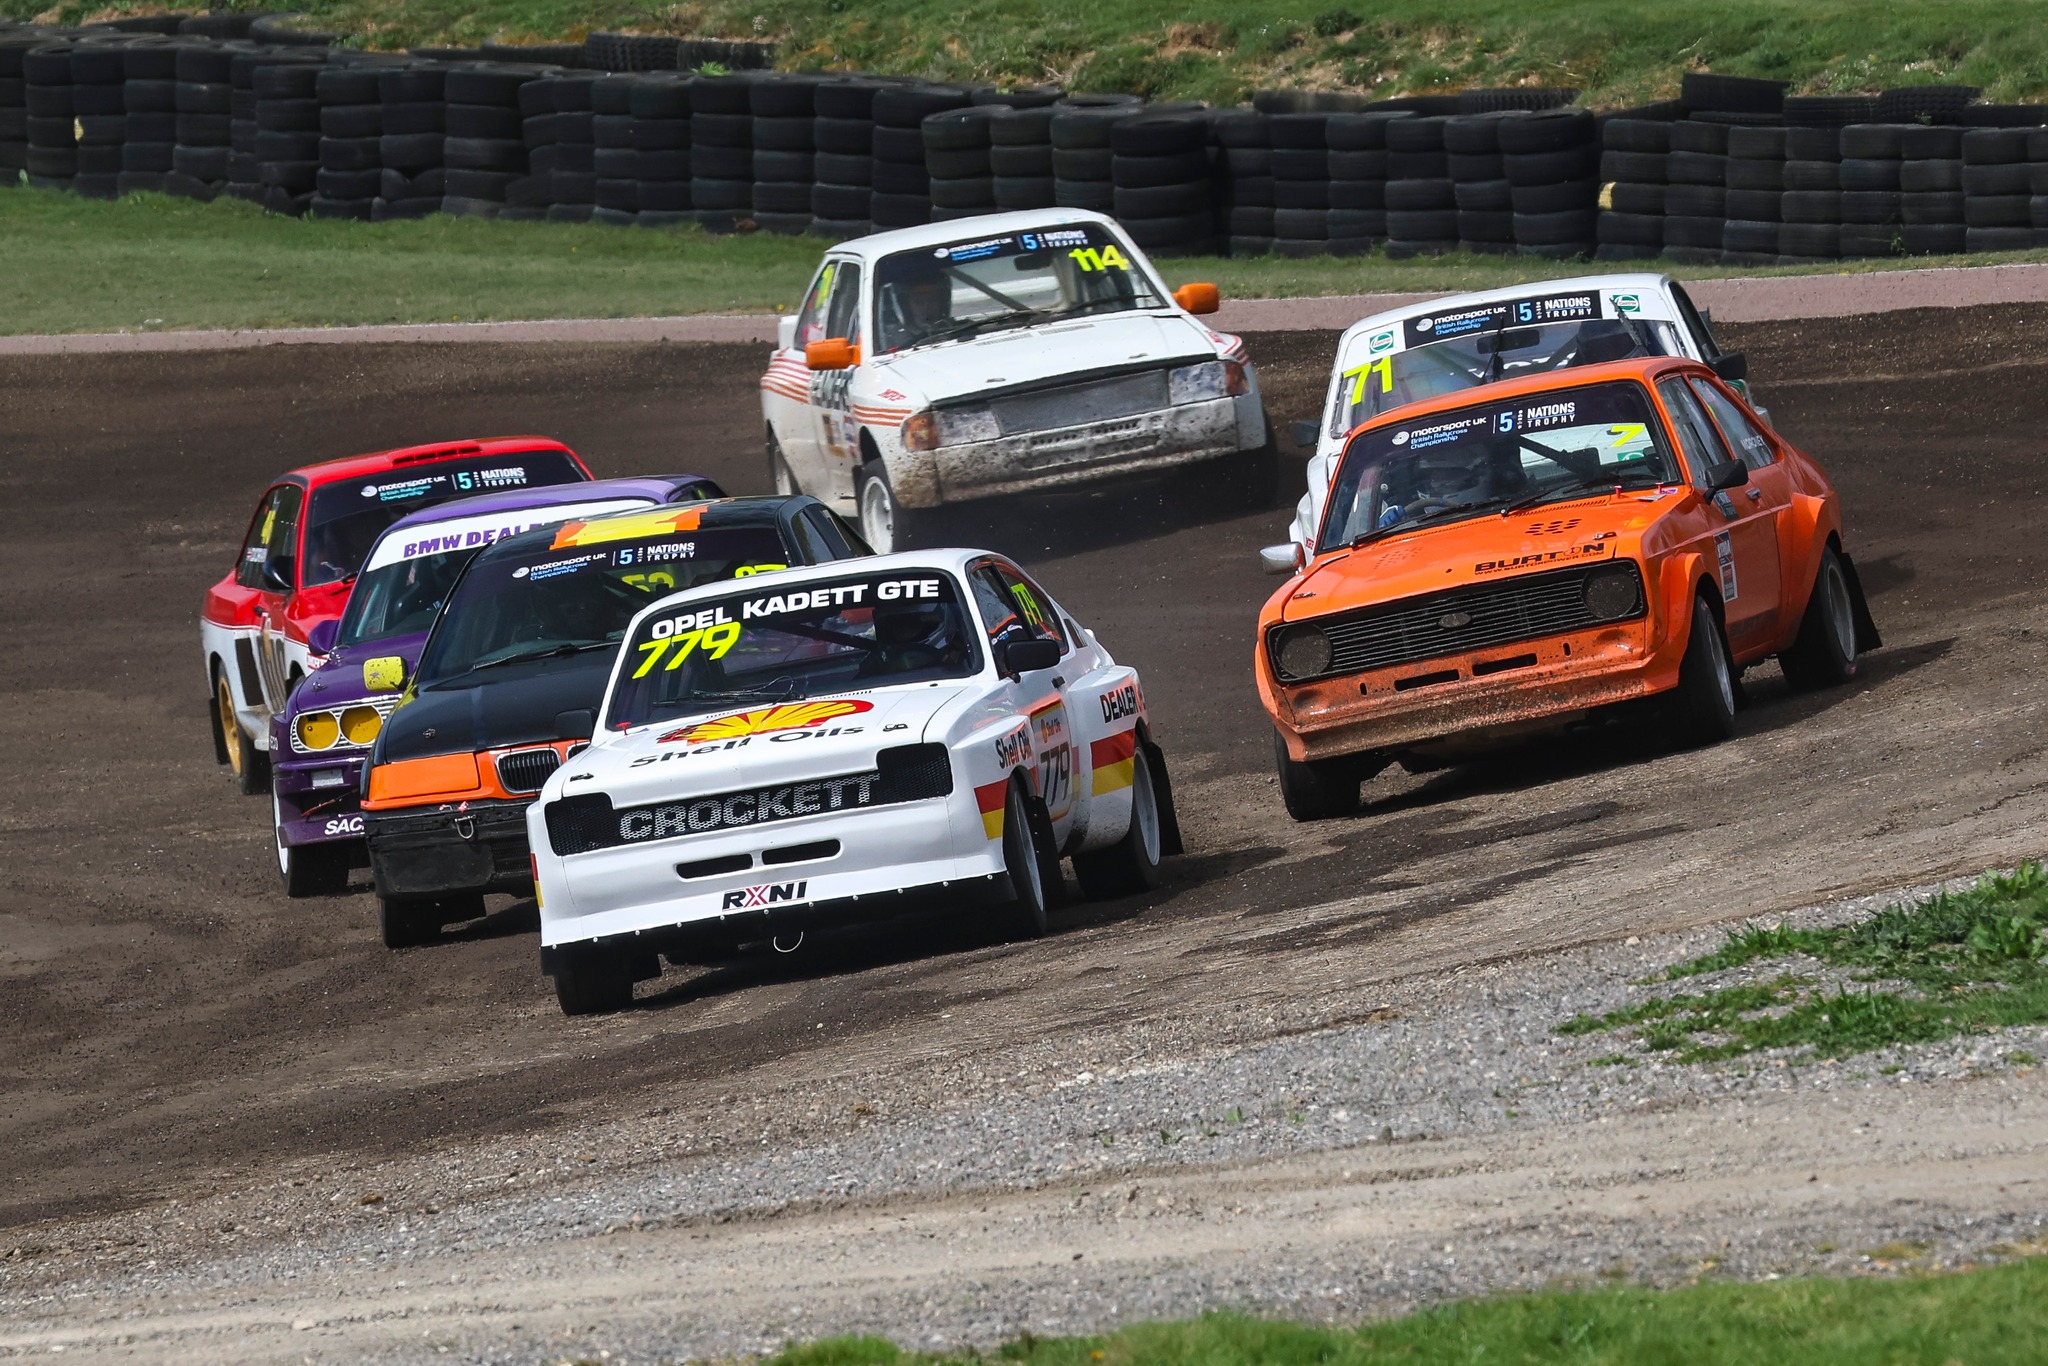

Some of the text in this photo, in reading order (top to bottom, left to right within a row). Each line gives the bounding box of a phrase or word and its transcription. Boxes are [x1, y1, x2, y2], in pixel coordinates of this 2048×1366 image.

[1022, 233, 1040, 250] 5
[1068, 245, 1128, 271] 114
[1519, 302, 1533, 322] 5
[1544, 296, 1591, 310] NATIONS
[1434, 306, 1506, 325] motorsport UK
[1545, 307, 1592, 319] TROPHY
[1435, 316, 1490, 331] British Rallycross
[1435, 323, 1482, 336] Championship
[1343, 355, 1393, 406] 71
[1527, 402, 1576, 419] NATIONS
[1411, 416, 1487, 438] motorsport UK
[1499, 411, 1513, 432] 5
[1527, 414, 1576, 428] TROPHY
[1411, 427, 1468, 446] British Rallycross
[1411, 434, 1458, 450] Championship
[1610, 424, 1645, 447] 7
[457, 472, 472, 489] 5
[481, 467, 525, 479] NATIONS
[483, 478, 527, 487] TROPHY
[378, 478, 432, 492] motorsport
[403, 523, 542, 558] BMW DEAL
[647, 542, 695, 554] NATIONS
[531, 552, 606, 572] motorsport UK
[619, 549, 634, 565] 5
[647, 551, 695, 562] TROPHY
[1475, 542, 1605, 572] BURTON
[530, 567, 577, 581] Championship
[651, 579, 939, 640] OPEL KADETT GTE
[631, 621, 742, 679] 779
[1100, 685, 1139, 723] DEALER
[629, 726, 865, 768] Shell Oils
[995, 734, 1020, 769] Shell
[1040, 741, 1070, 807] 779
[619, 772, 881, 841] CROCKETT
[324, 817, 364, 835] SAC
[721, 880, 808, 912] RXNI
